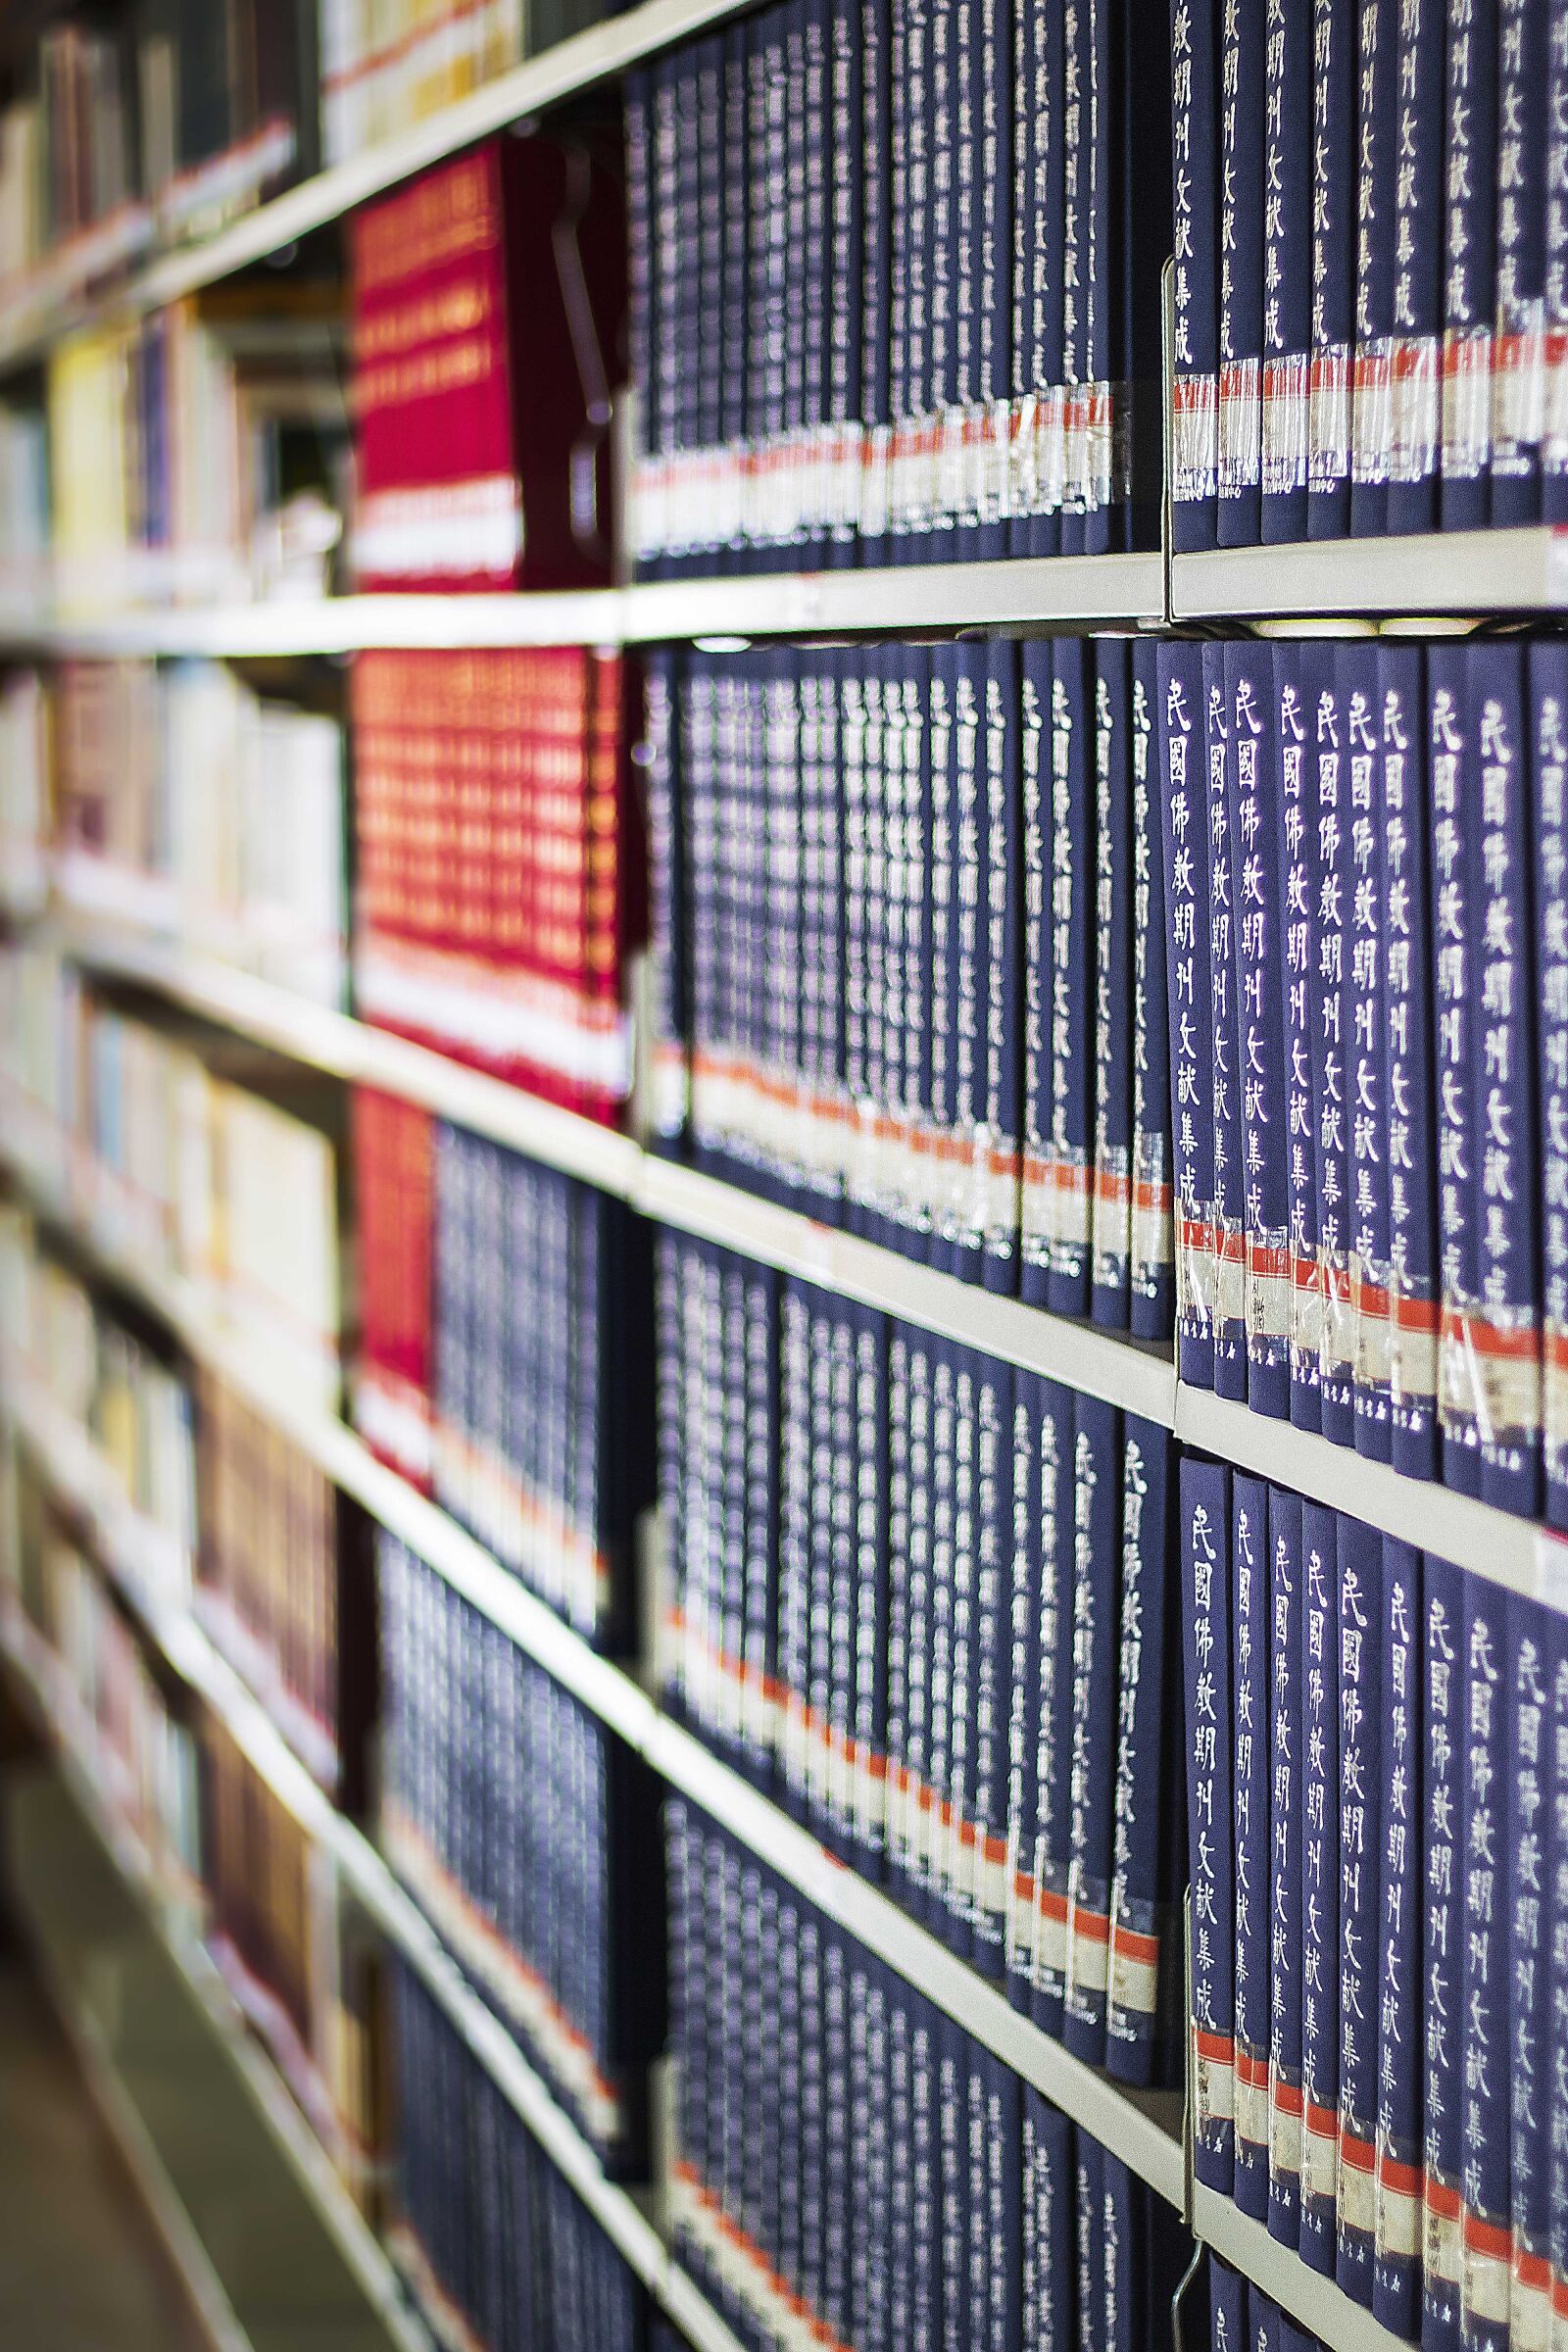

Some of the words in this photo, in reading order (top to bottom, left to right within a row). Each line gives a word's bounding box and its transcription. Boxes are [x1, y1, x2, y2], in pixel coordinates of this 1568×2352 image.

[1173, 0, 1193, 365] 教期刊文献集成
